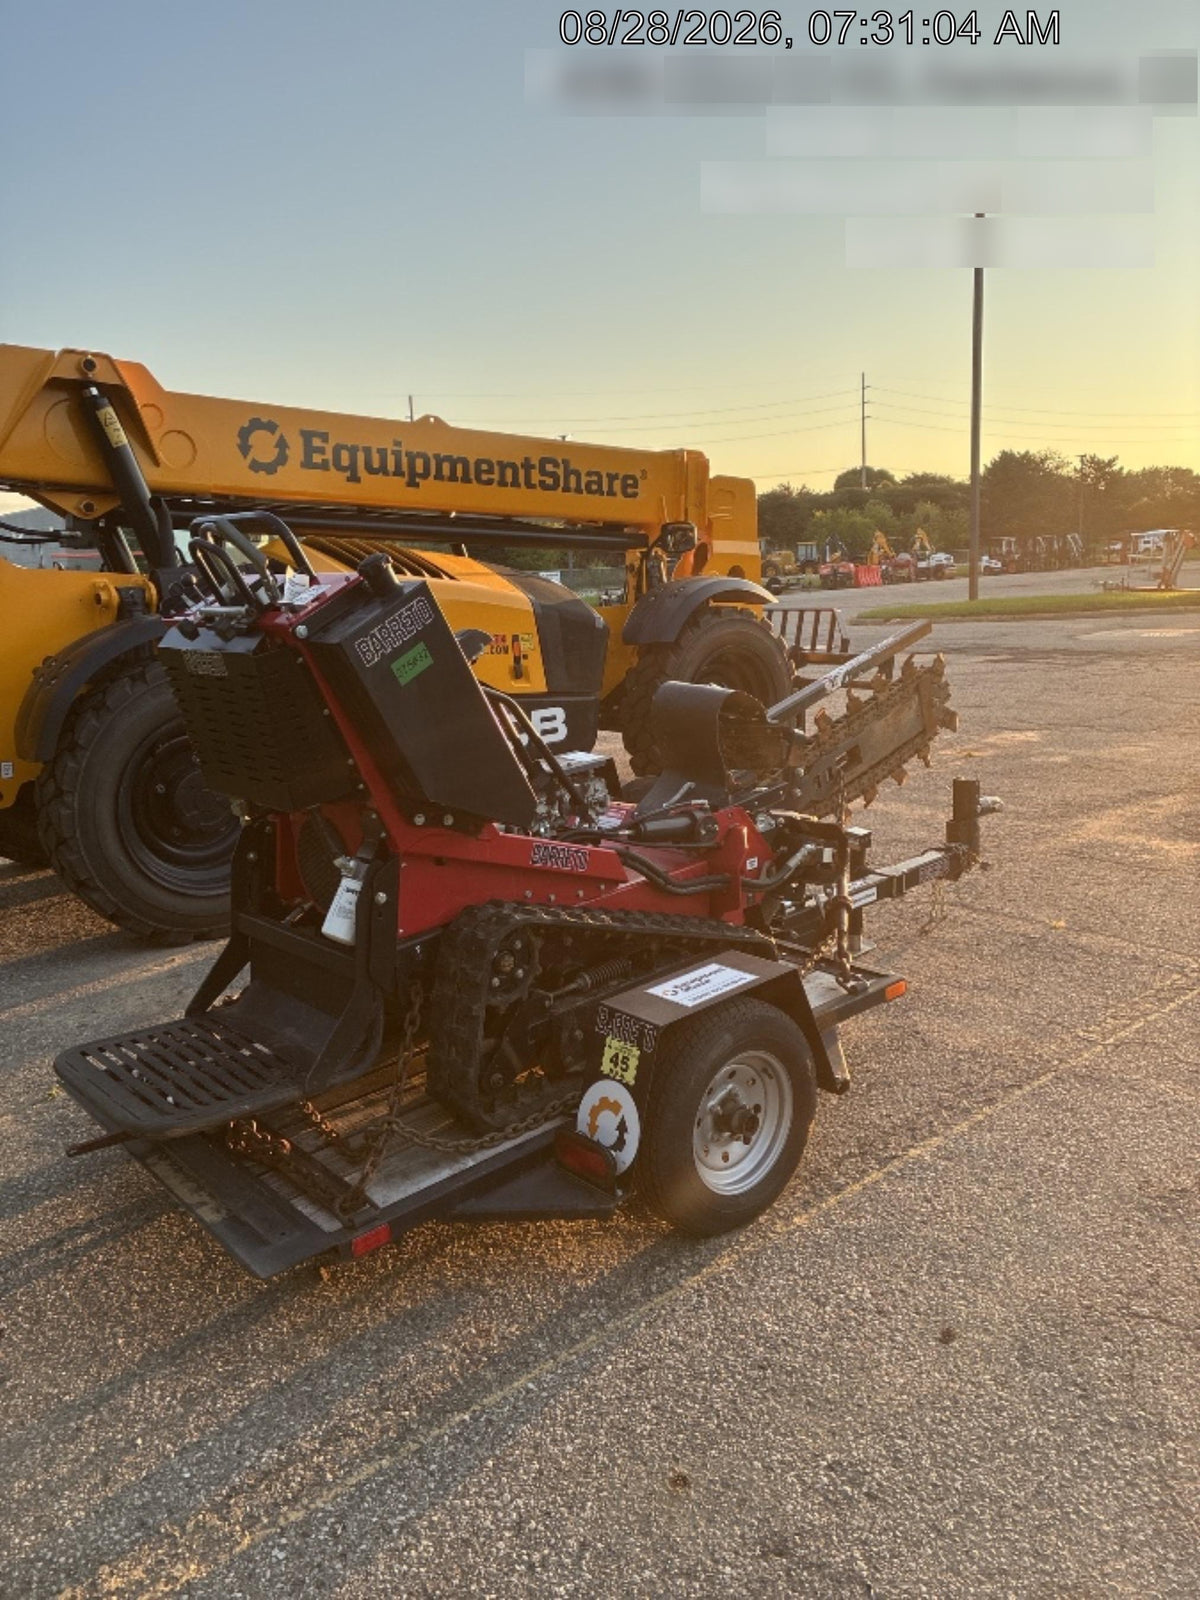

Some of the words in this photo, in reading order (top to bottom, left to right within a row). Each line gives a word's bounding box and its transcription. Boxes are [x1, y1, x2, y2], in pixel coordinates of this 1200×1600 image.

[299, 429, 640, 499] EquipmentShare
[354, 597, 434, 668] BARRETO
[609, 1052, 631, 1073] 45
